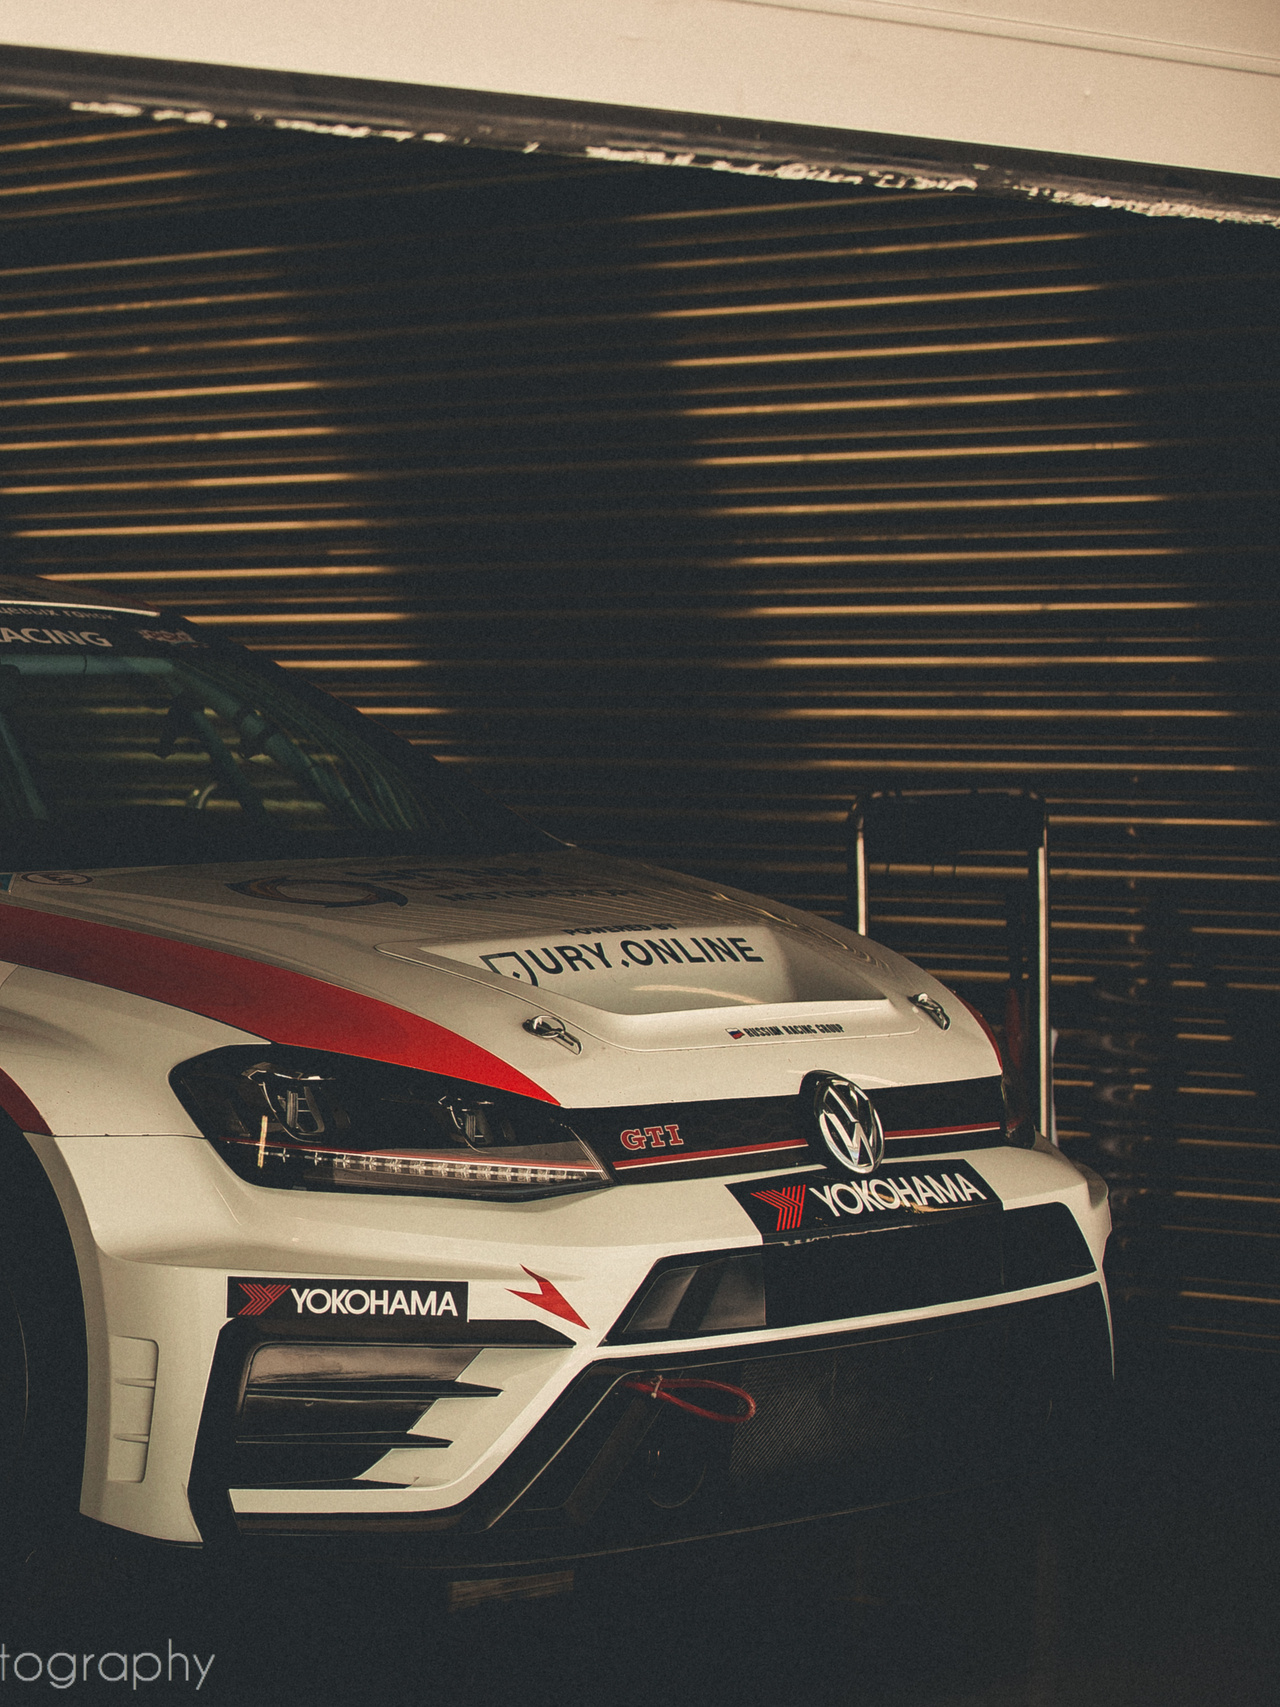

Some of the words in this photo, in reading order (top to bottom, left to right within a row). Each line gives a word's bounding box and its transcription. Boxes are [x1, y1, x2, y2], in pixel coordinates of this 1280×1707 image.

[561, 924, 652, 936] POWERED
[652, 923, 678, 931] BY
[781, 1025, 818, 1035] RACING
[620, 1124, 684, 1151] GTI
[808, 1172, 987, 1218] YOKOHAMA
[290, 1287, 459, 1317] YOKOHAMA
